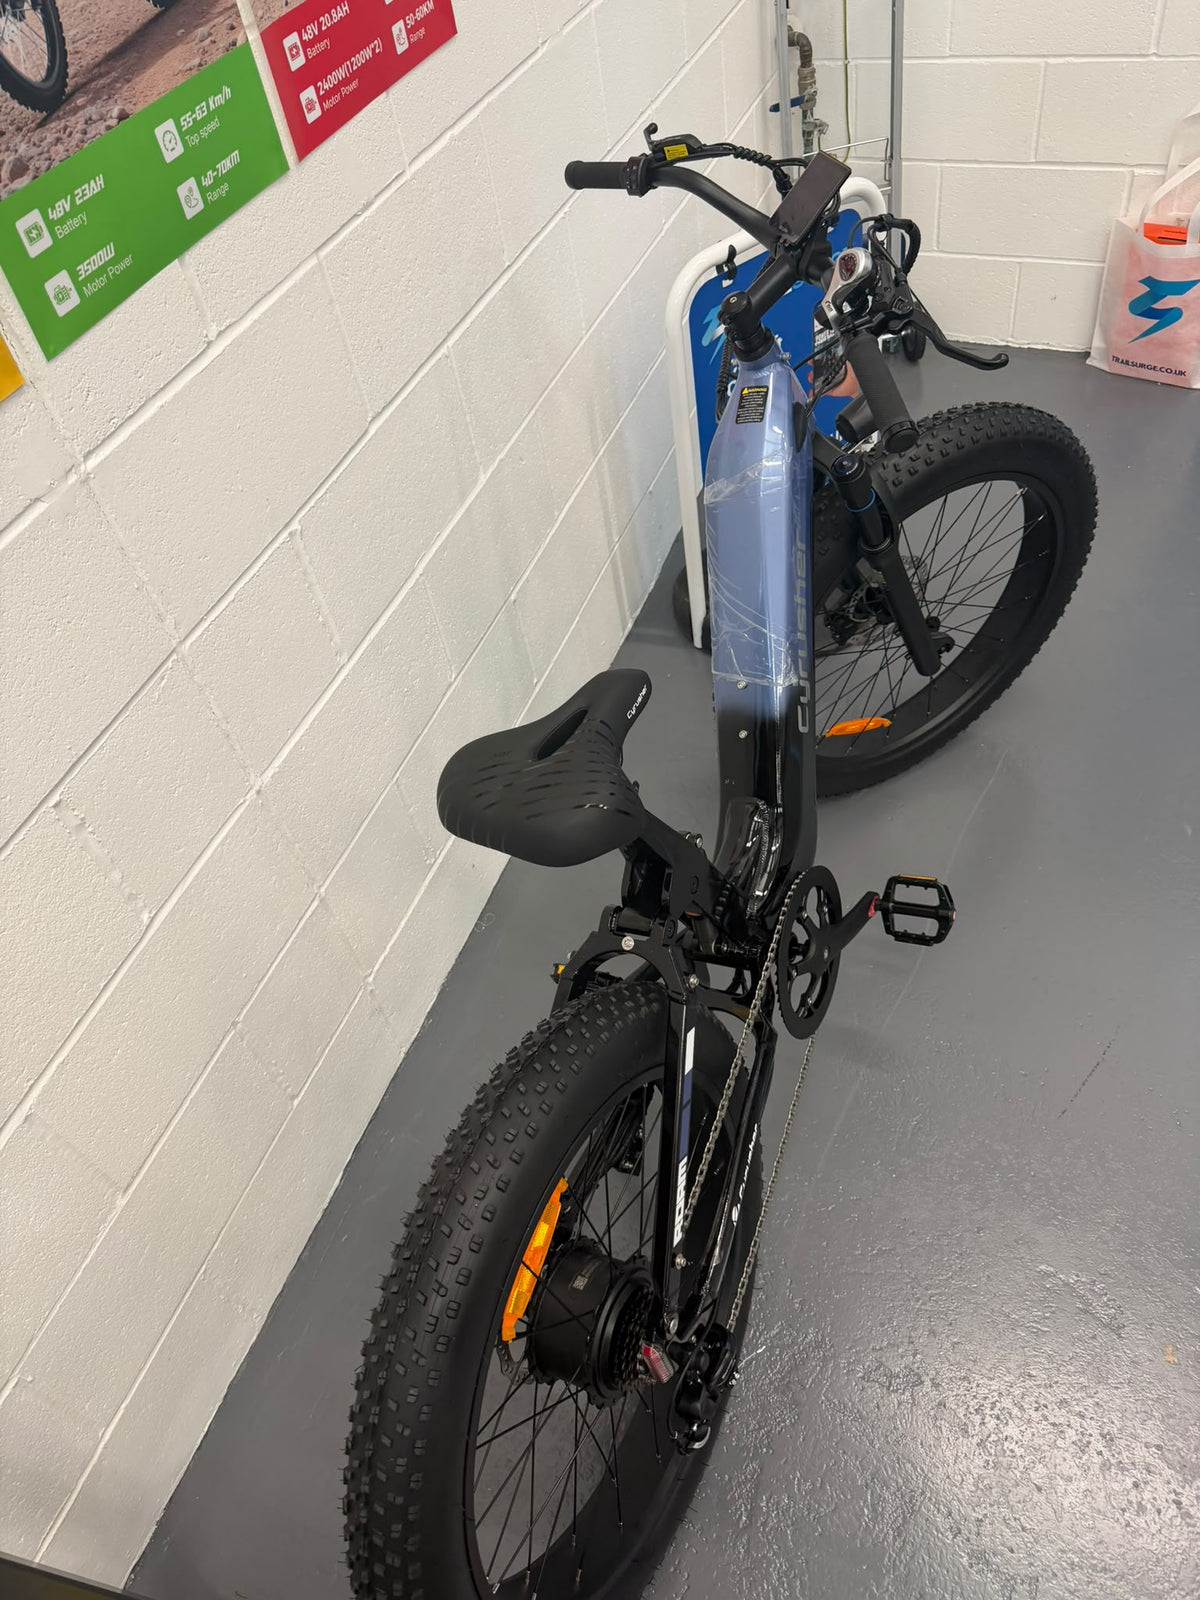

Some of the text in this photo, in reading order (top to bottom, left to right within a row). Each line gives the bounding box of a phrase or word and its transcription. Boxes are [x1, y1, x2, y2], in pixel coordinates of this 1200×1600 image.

[301, 1, 350, 42] 48V 20.8AH
[405, 0, 435, 29] 50-60KM
[306, 37, 330, 60] Battery
[409, 27, 426, 44] Range
[180, 85, 232, 131] 55-63 Km/h
[322, 78, 360, 111] Motor Power
[185, 115, 220, 148] Top speed
[201, 150, 240, 188] 40-70KM
[48, 174, 105, 221] 48V 23AH
[206, 182, 229, 204] Range
[55, 211, 87, 239] Battery
[76, 243, 115, 281] 3500W
[83, 254, 133, 298] Motor Power
[1112, 355, 1186, 377] TRAILSURGE.CO.UK
[794, 525, 811, 734] Cyrusher
[627, 684, 647, 719] Cyrusher
[673, 1155, 688, 1248] ROAM
